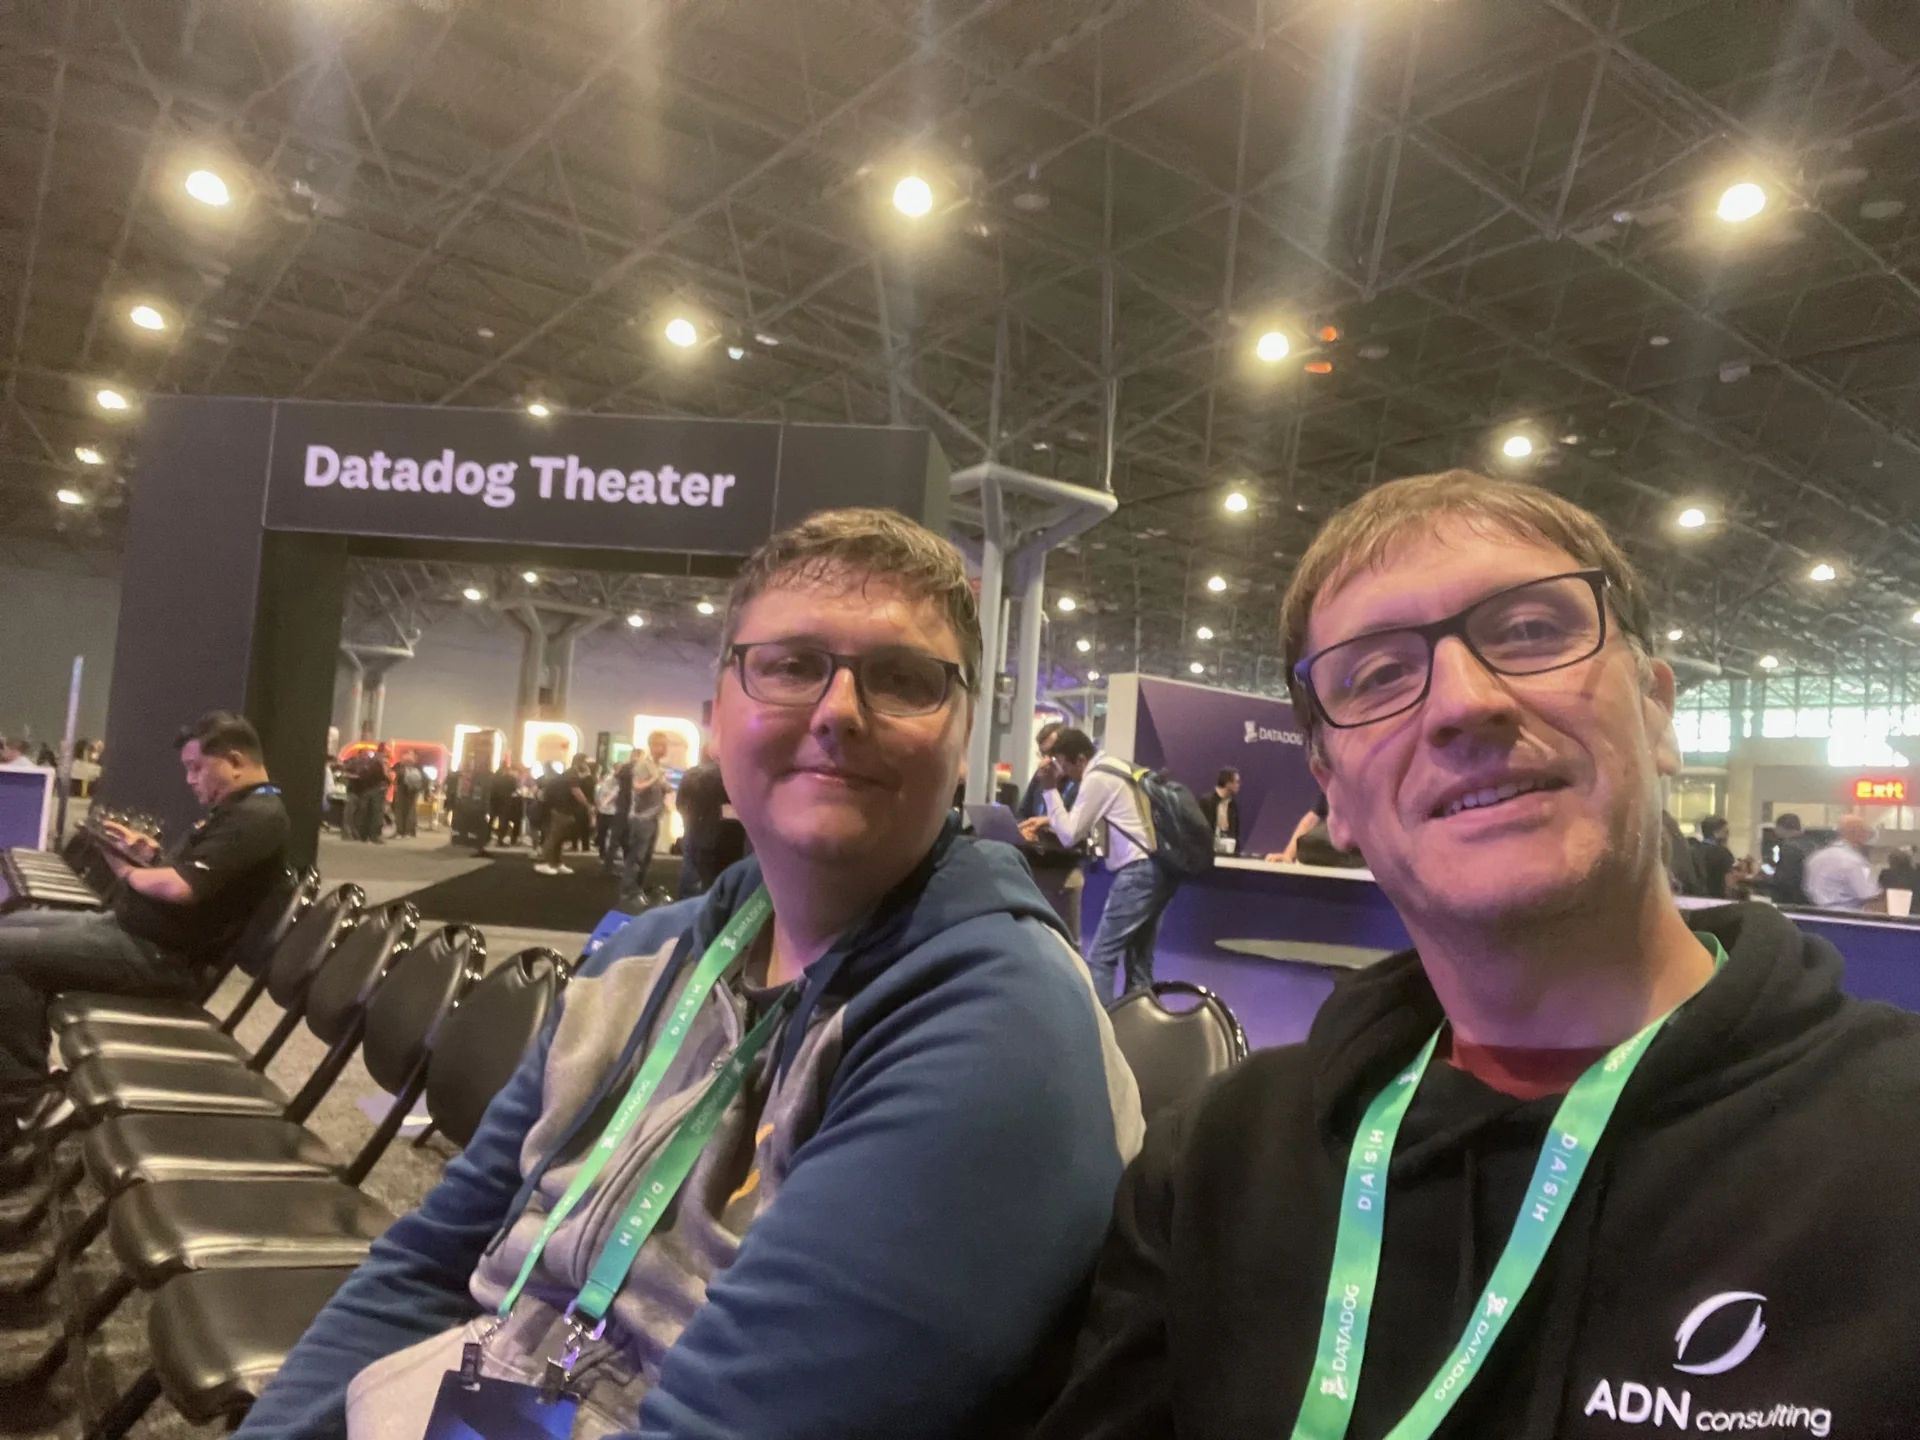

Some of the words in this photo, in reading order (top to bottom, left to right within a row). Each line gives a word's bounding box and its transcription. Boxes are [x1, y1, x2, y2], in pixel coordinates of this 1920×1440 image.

[304, 445, 518, 508] Datadog
[529, 455, 736, 507] Theater
[1856, 780, 1904, 799] Exit
[1332, 1284, 1360, 1373] DATADOG
[1434, 1319, 1490, 1402] DATADOG
[1584, 1379, 1691, 1431] ADN
[1696, 1403, 1832, 1438] consulting
